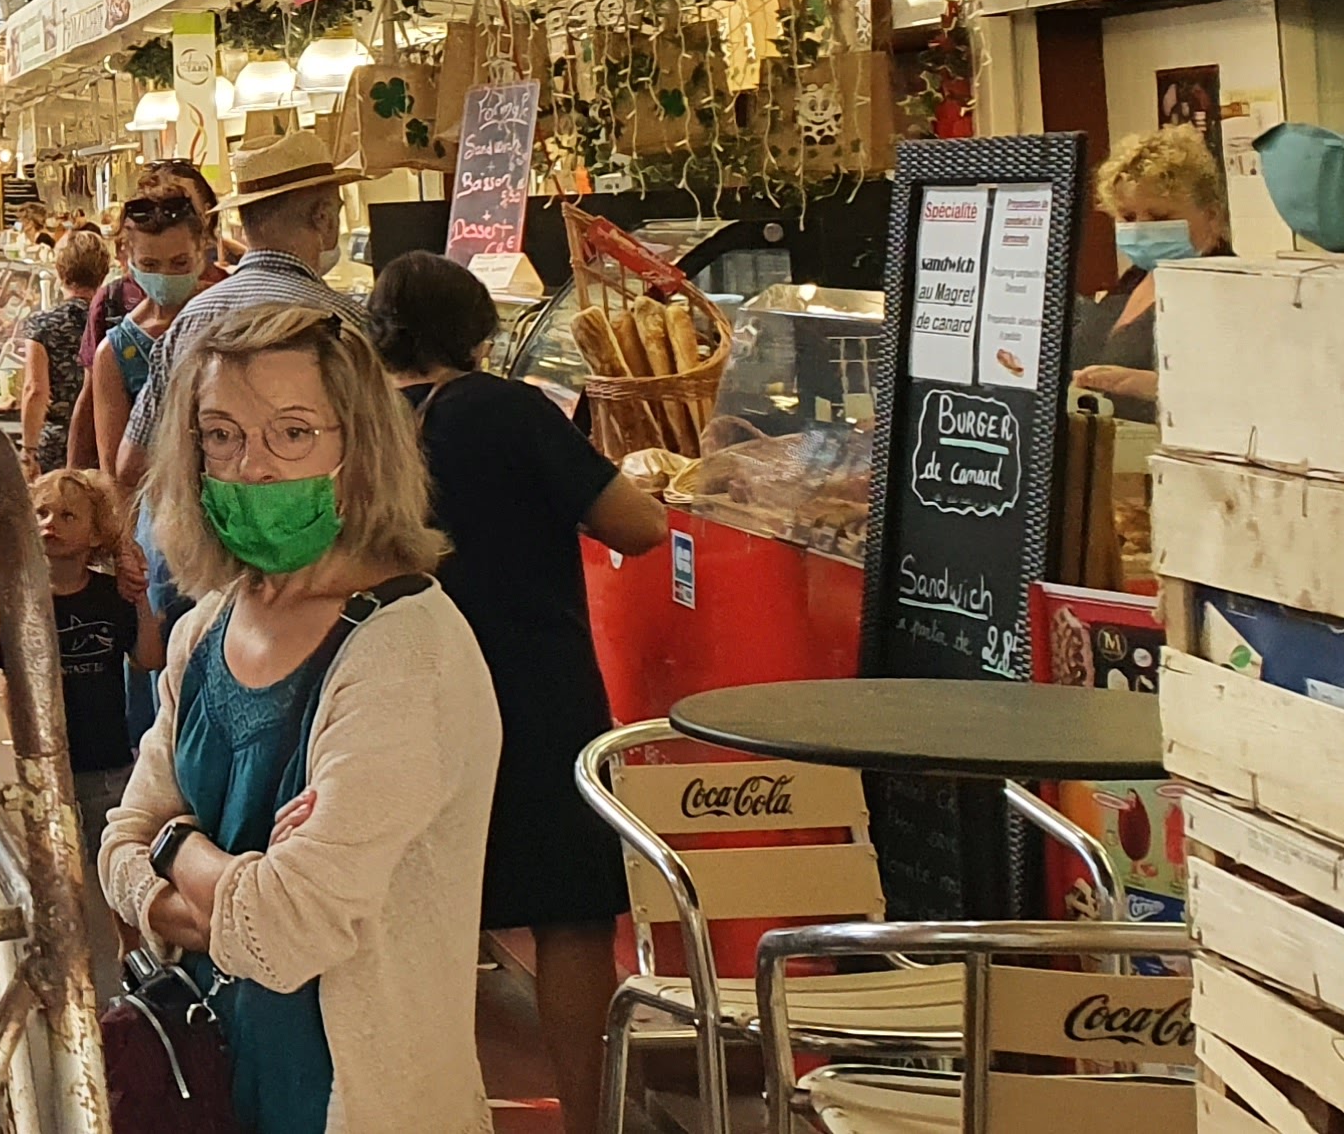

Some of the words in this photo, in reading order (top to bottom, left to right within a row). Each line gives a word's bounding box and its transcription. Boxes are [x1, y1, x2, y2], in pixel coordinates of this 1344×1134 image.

[924, 201, 978, 219] Spécialité
[921, 257, 975, 273] sandwich
[918, 286, 933, 300] au
[934, 283, 975, 305] Magret
[916, 313, 931, 329] de
[932, 316, 973, 333] canard
[938, 394, 1013, 441] BURGER
[919, 451, 942, 481] de
[900, 554, 993, 617] Sandwich
[681, 775, 795, 818] Coca-Cola
[1064, 994, 1196, 1046] Coca-Co
